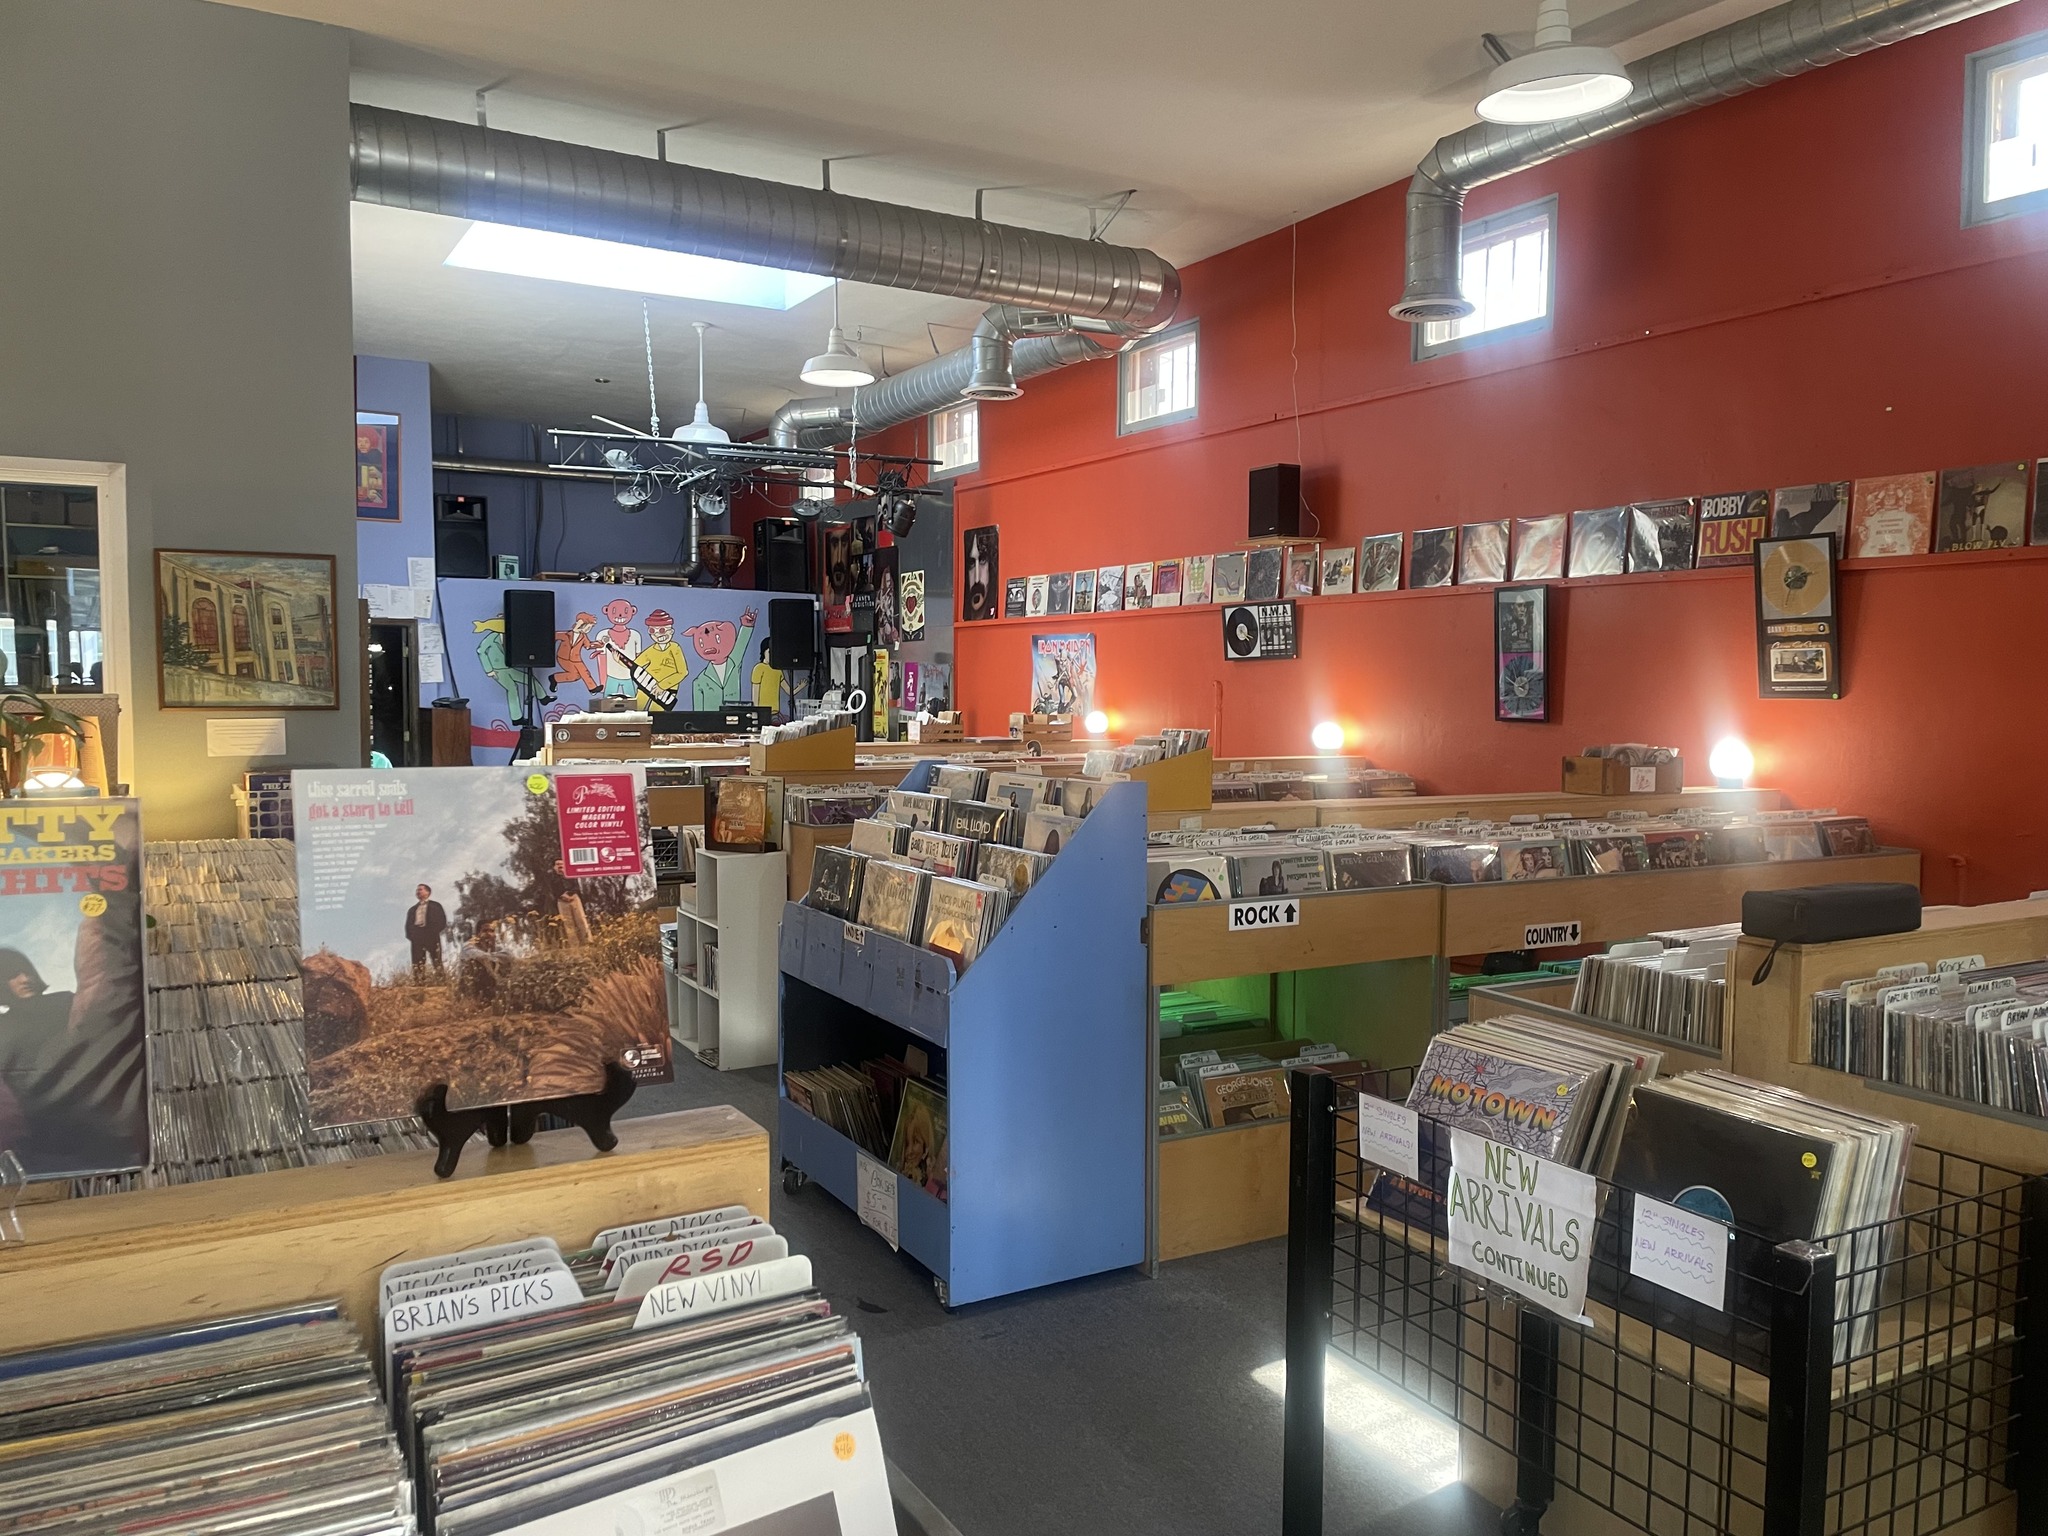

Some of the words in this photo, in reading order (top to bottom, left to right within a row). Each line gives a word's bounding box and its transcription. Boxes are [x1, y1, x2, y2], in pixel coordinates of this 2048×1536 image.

[1702, 495, 1745, 518] BOBBY
[1702, 518, 1763, 554] RUSH
[1952, 542, 1983, 551] BLOW
[1262, 605, 1289, 616] N.W.A
[1038, 639, 1058, 655] IRON
[262, 782, 281, 790] THE
[335, 779, 376, 801] sacred
[378, 779, 408, 800] souls
[341, 803, 375, 821] story
[378, 803, 391, 816] to
[394, 799, 415, 815] tell
[566, 806, 596, 814] LIMITED
[597, 805, 626, 813] EDITION
[581, 813, 615, 821] MAGENTA
[574, 821, 598, 829] COLOR
[600, 820, 624, 828] VINYL!
[955, 818, 970, 831] BILL
[970, 817, 991, 834] LLOYD
[1195, 839, 1216, 848] ROCK
[1340, 857, 1363, 865] STEVE
[1, 865, 128, 895] HITS
[1234, 904, 1280, 926] ROCK
[845, 924, 860, 940] INDIE
[1526, 926, 1569, 945] COUNTRY
[1940, 961, 1965, 973] ROCK
[1968, 958, 1977, 968] A
[1967, 983, 1989, 995] ALLMAN
[2006, 1008, 2030, 1026] BRYAN
[1216, 1076, 1247, 1095] GEORGE
[1248, 1076, 1274, 1088] JONES
[1427, 1075, 1559, 1132] MOTOWN
[1377, 1106, 1407, 1126] SINGLES
[1362, 1126, 1377, 1138] NEW
[1484, 1140, 1539, 1195] NEW
[1450, 1172, 1579, 1261] ARRIVALS
[1662, 1215, 1706, 1241] SINGLES
[658, 1241, 753, 1285] RSD
[1634, 1238, 1657, 1252] NEW
[1664, 1246, 1714, 1274] ARRIVALS
[1471, 1240, 1569, 1299] CONTINUED
[393, 1293, 480, 1332] BRIAN'S
[490, 1278, 554, 1312] PICKS
[650, 1283, 696, 1318] NEW
